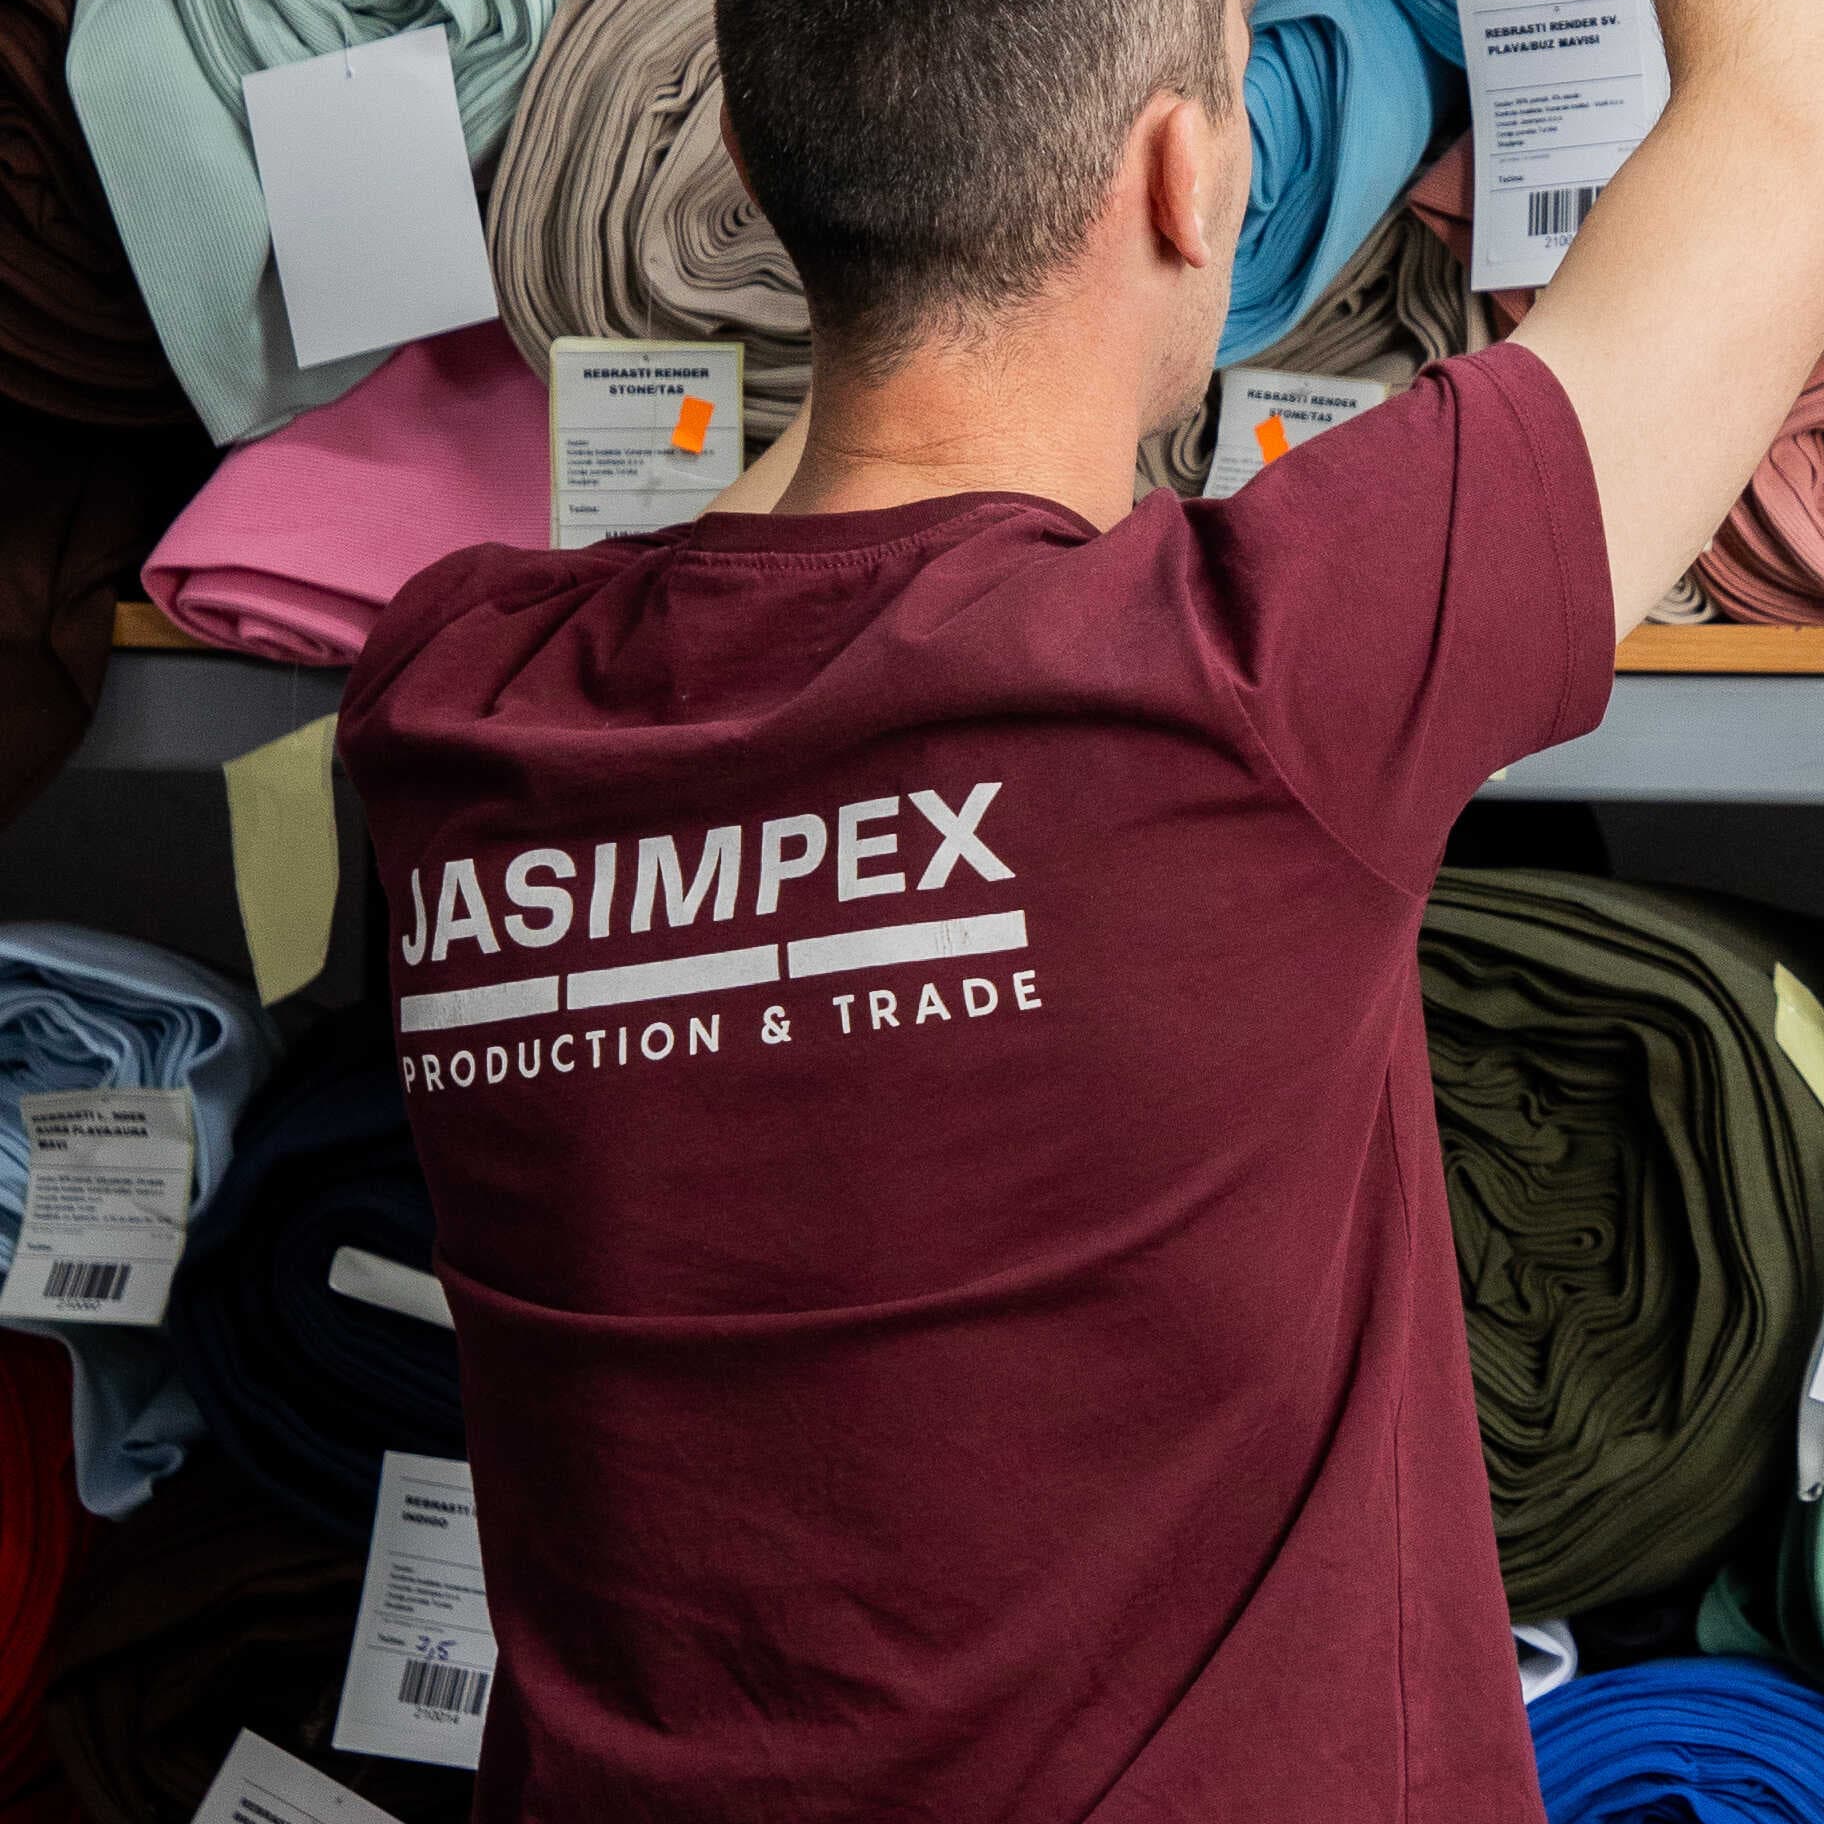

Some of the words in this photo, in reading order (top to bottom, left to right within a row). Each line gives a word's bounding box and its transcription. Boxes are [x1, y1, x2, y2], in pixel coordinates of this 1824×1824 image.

[1484, 21, 1547, 40] REBRASTI
[1550, 16, 1598, 33] RENDER
[1600, 13, 1621, 26] SV.
[1487, 39, 1555, 56] PLAVA/BUZ
[1558, 34, 1600, 48] MAVISI
[583, 367, 651, 379] REBRASTI
[655, 368, 710, 378] RENDER
[609, 384, 685, 395] STONE/TAS
[1310, 395, 1358, 409] RENDER
[401, 781, 1018, 968] JASIMPEX
[401, 1013, 722, 1096] PRODUCTION
[759, 1004, 794, 1046] &
[832, 969, 1045, 1036] TRADE
